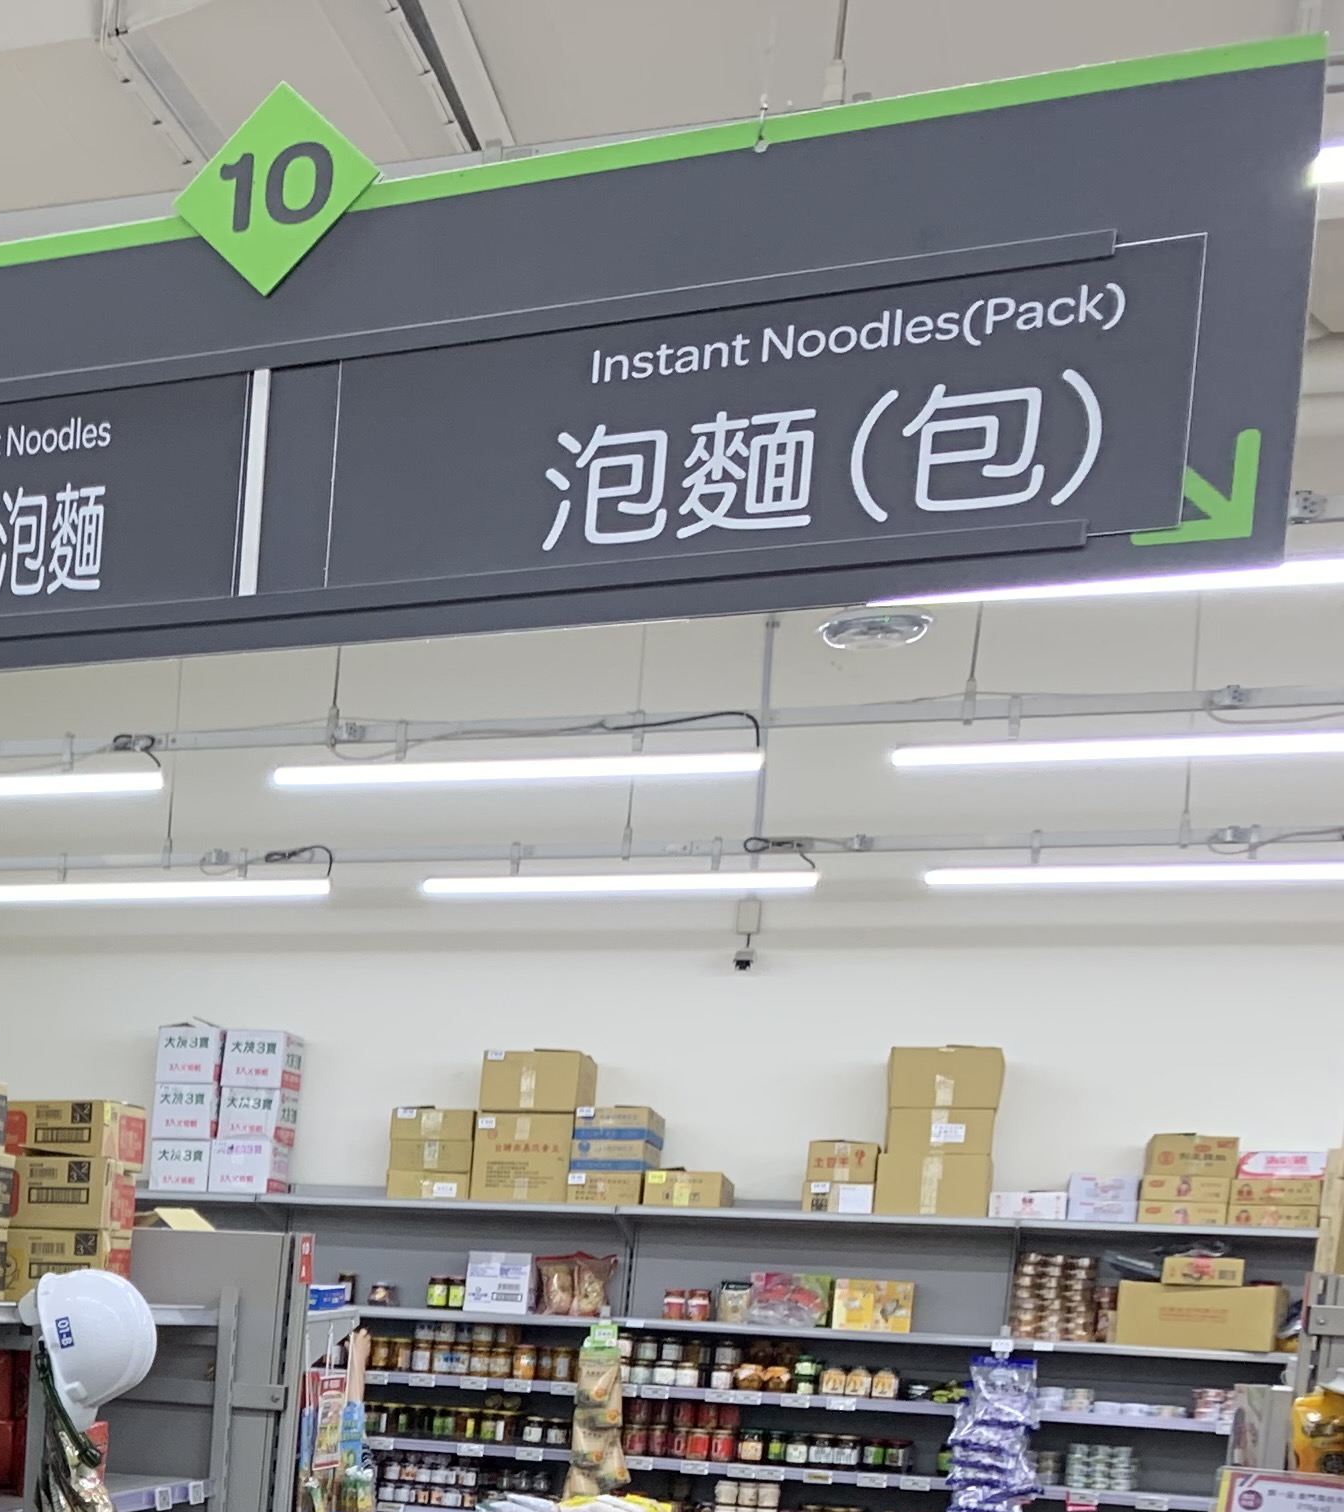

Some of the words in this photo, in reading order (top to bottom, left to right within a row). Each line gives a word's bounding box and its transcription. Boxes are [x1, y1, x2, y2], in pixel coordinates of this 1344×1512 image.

[218, 140, 334, 235] 10
[591, 334, 750, 386] Instant
[759, 283, 1127, 364] Noodles(Pack)
[5, 417, 112, 460] Noodles
